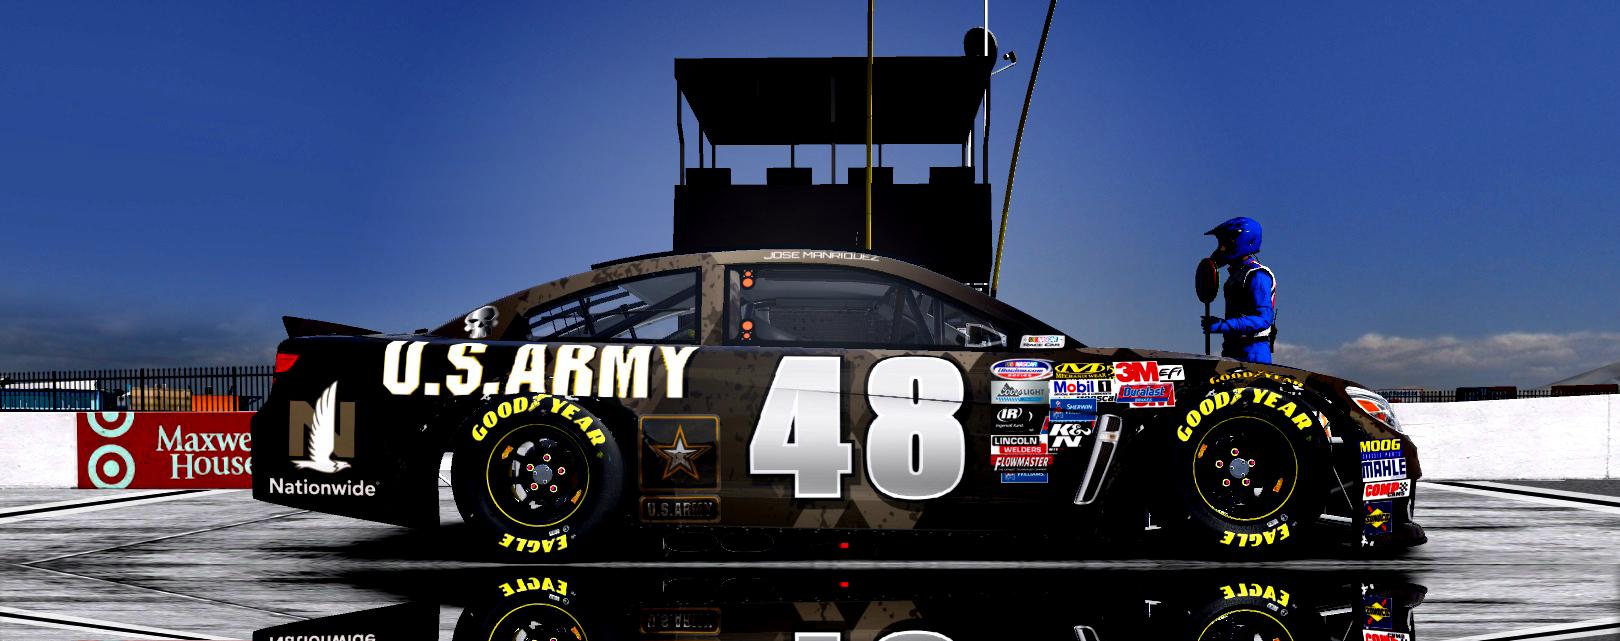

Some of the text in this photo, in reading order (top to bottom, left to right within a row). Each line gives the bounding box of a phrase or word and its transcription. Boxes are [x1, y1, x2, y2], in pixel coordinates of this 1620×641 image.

[763, 251, 879, 261] JOSE MANRIQUEZ
[1115, 361, 1159, 382] 3M
[1054, 381, 1094, 393] Mobil
[1123, 385, 1165, 397] Duralast
[750, 356, 965, 500] 48
[994, 437, 1037, 445] LINCOLN
[1360, 439, 1401, 452] MOOG
[994, 457, 1049, 471] FLOWMASTER
[1362, 459, 1406, 479] MAHLE
[269, 477, 376, 497] Nationwide
[1365, 482, 1400, 497] COMP
[1220, 523, 1290, 547] EAGLE
[498, 533, 568, 553] EAGLE
